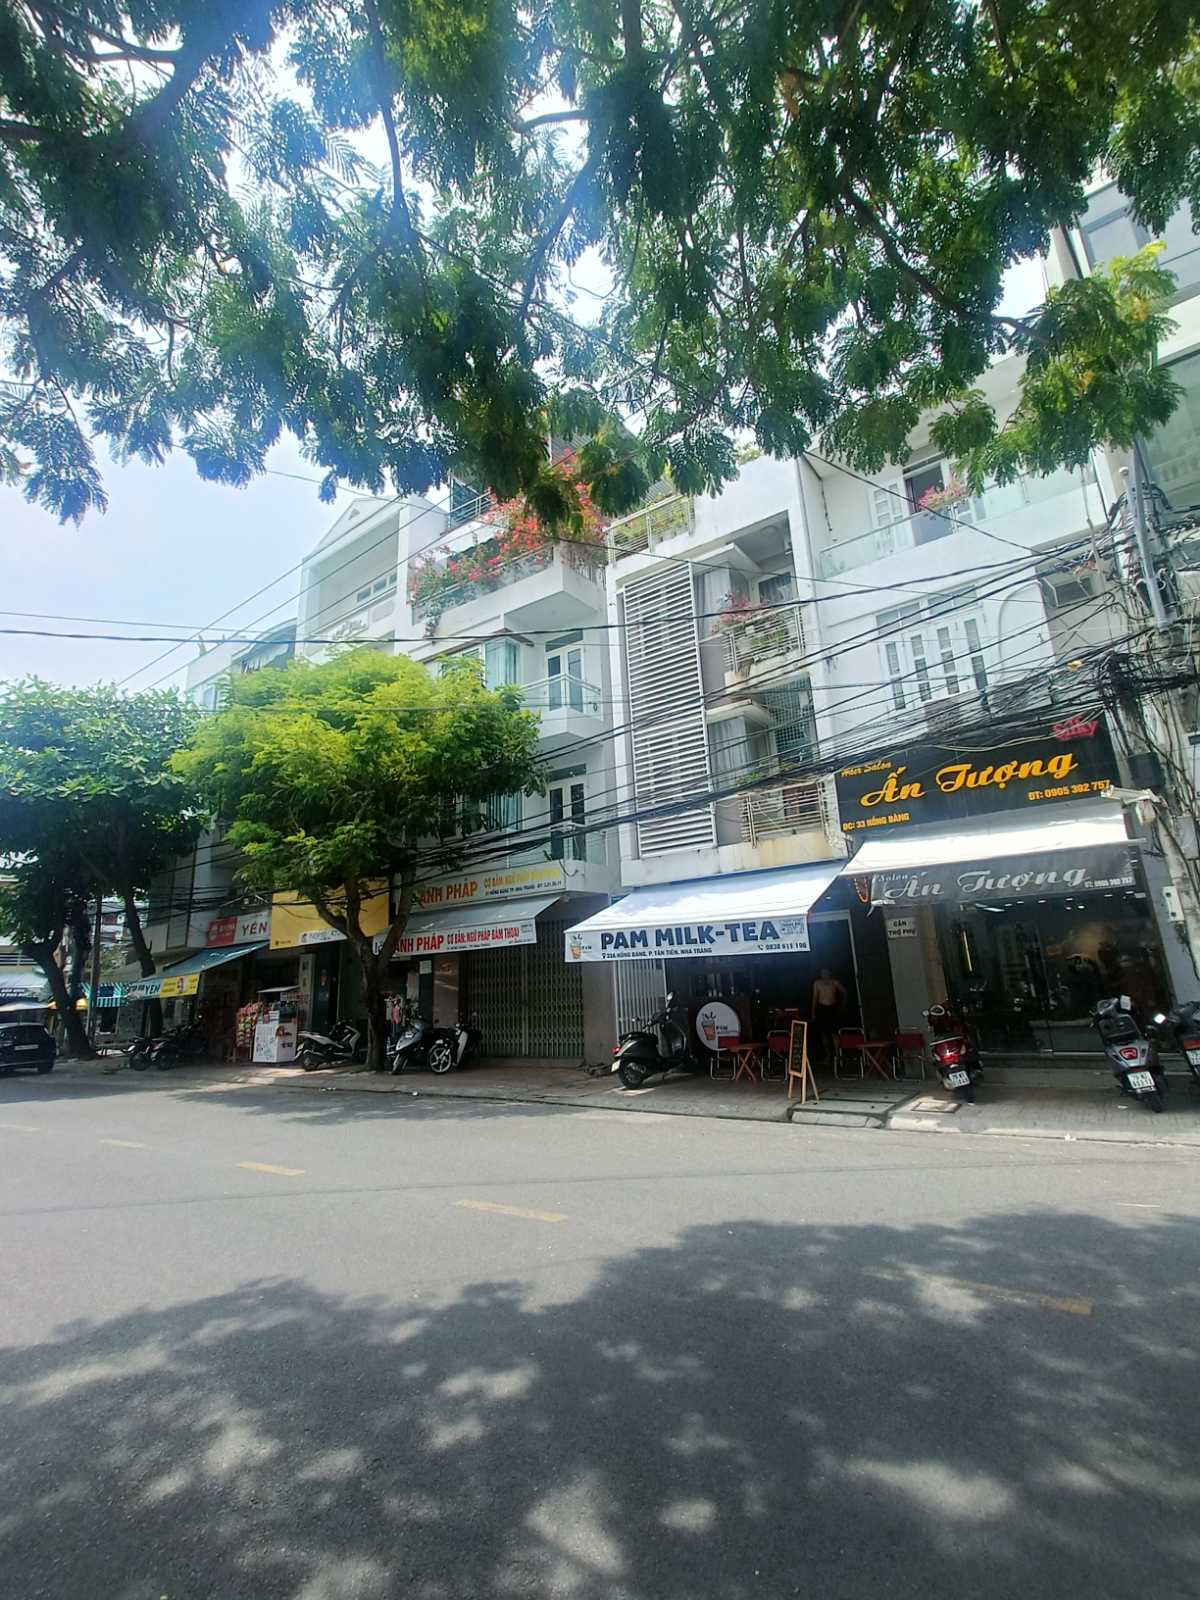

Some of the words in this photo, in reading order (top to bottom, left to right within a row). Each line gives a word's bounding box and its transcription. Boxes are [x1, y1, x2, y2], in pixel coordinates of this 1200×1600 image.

[859, 766, 926, 807] Ấn
[935, 752, 1078, 791] Tượng
[446, 877, 478, 900] PHÁP
[885, 872, 943, 898] Ấn
[957, 867, 1090, 891] Tượng
[416, 932, 445, 951] PHÁP
[601, 930, 648, 950] PAM
[655, 920, 780, 947] MILK-TEA
